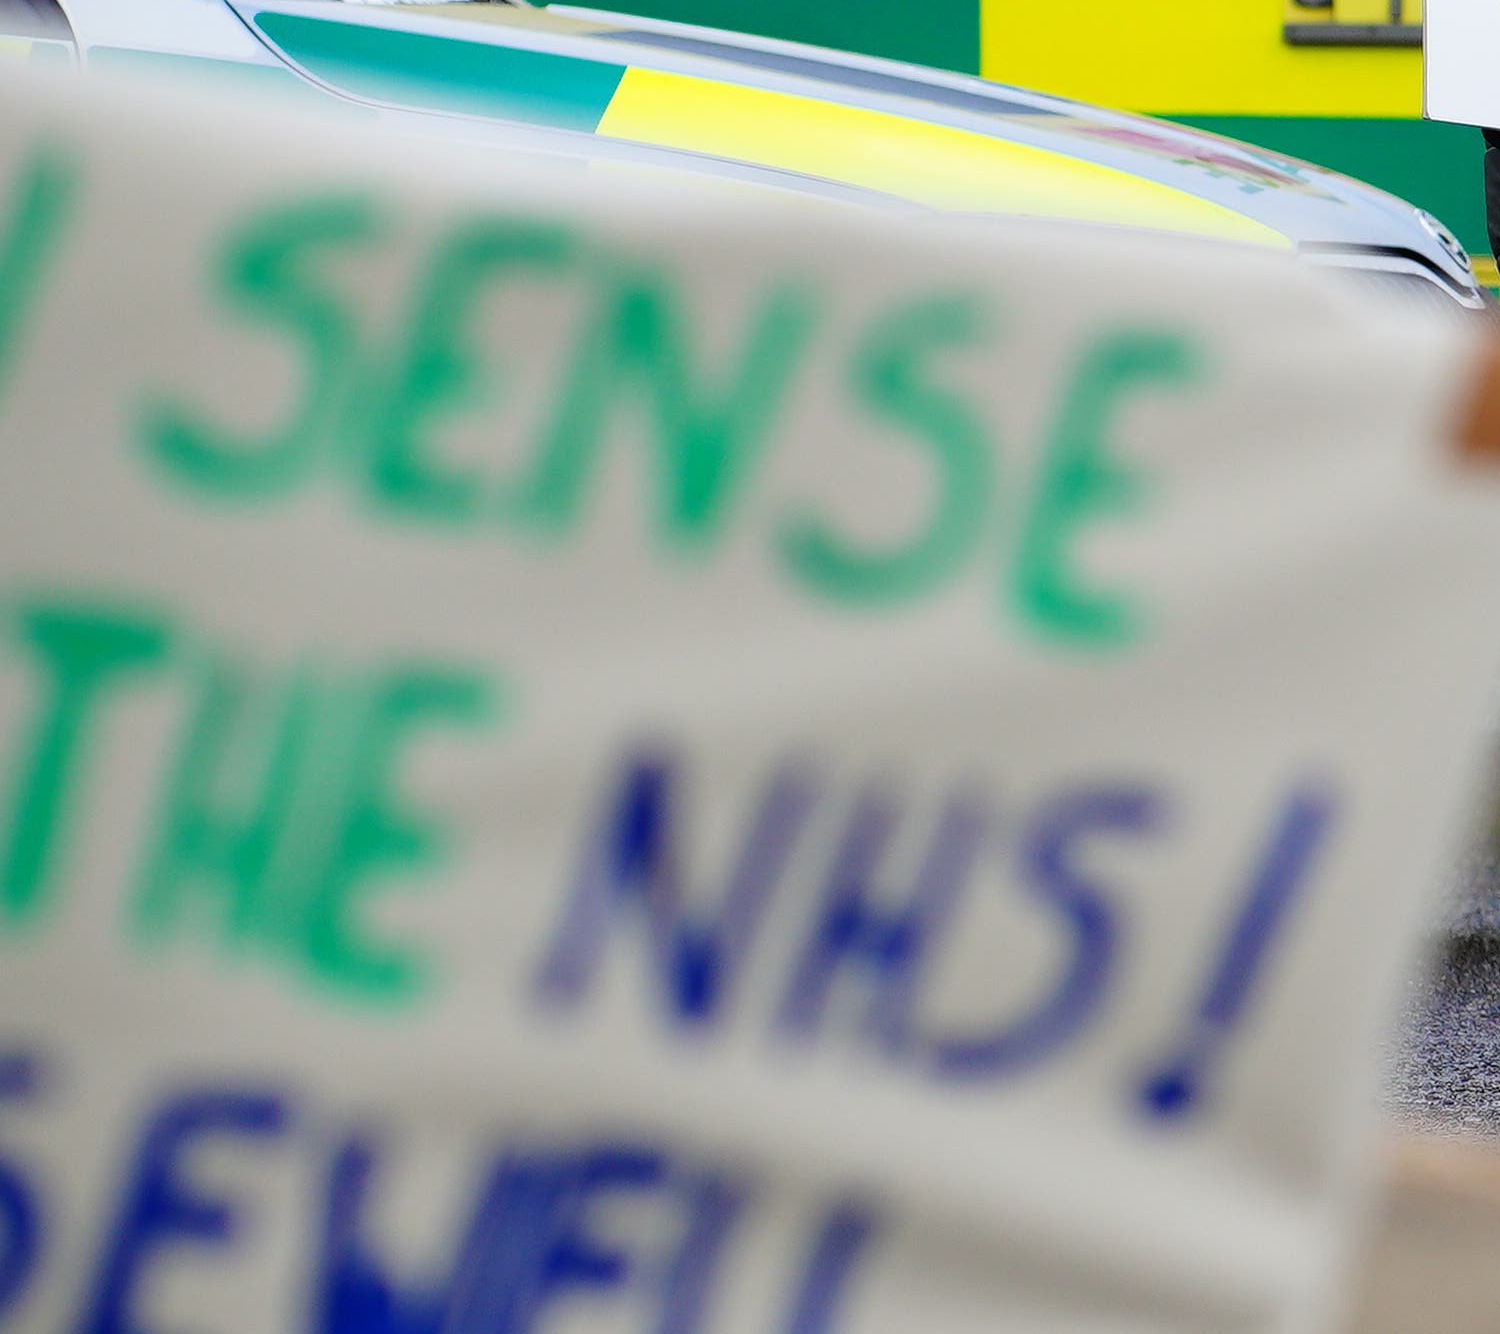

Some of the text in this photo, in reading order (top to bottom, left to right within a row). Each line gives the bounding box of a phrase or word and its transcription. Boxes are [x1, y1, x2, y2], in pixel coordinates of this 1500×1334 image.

[130, 182, 1215, 657] SENSE
[0, 592, 1340, 1132] THE NHS!
